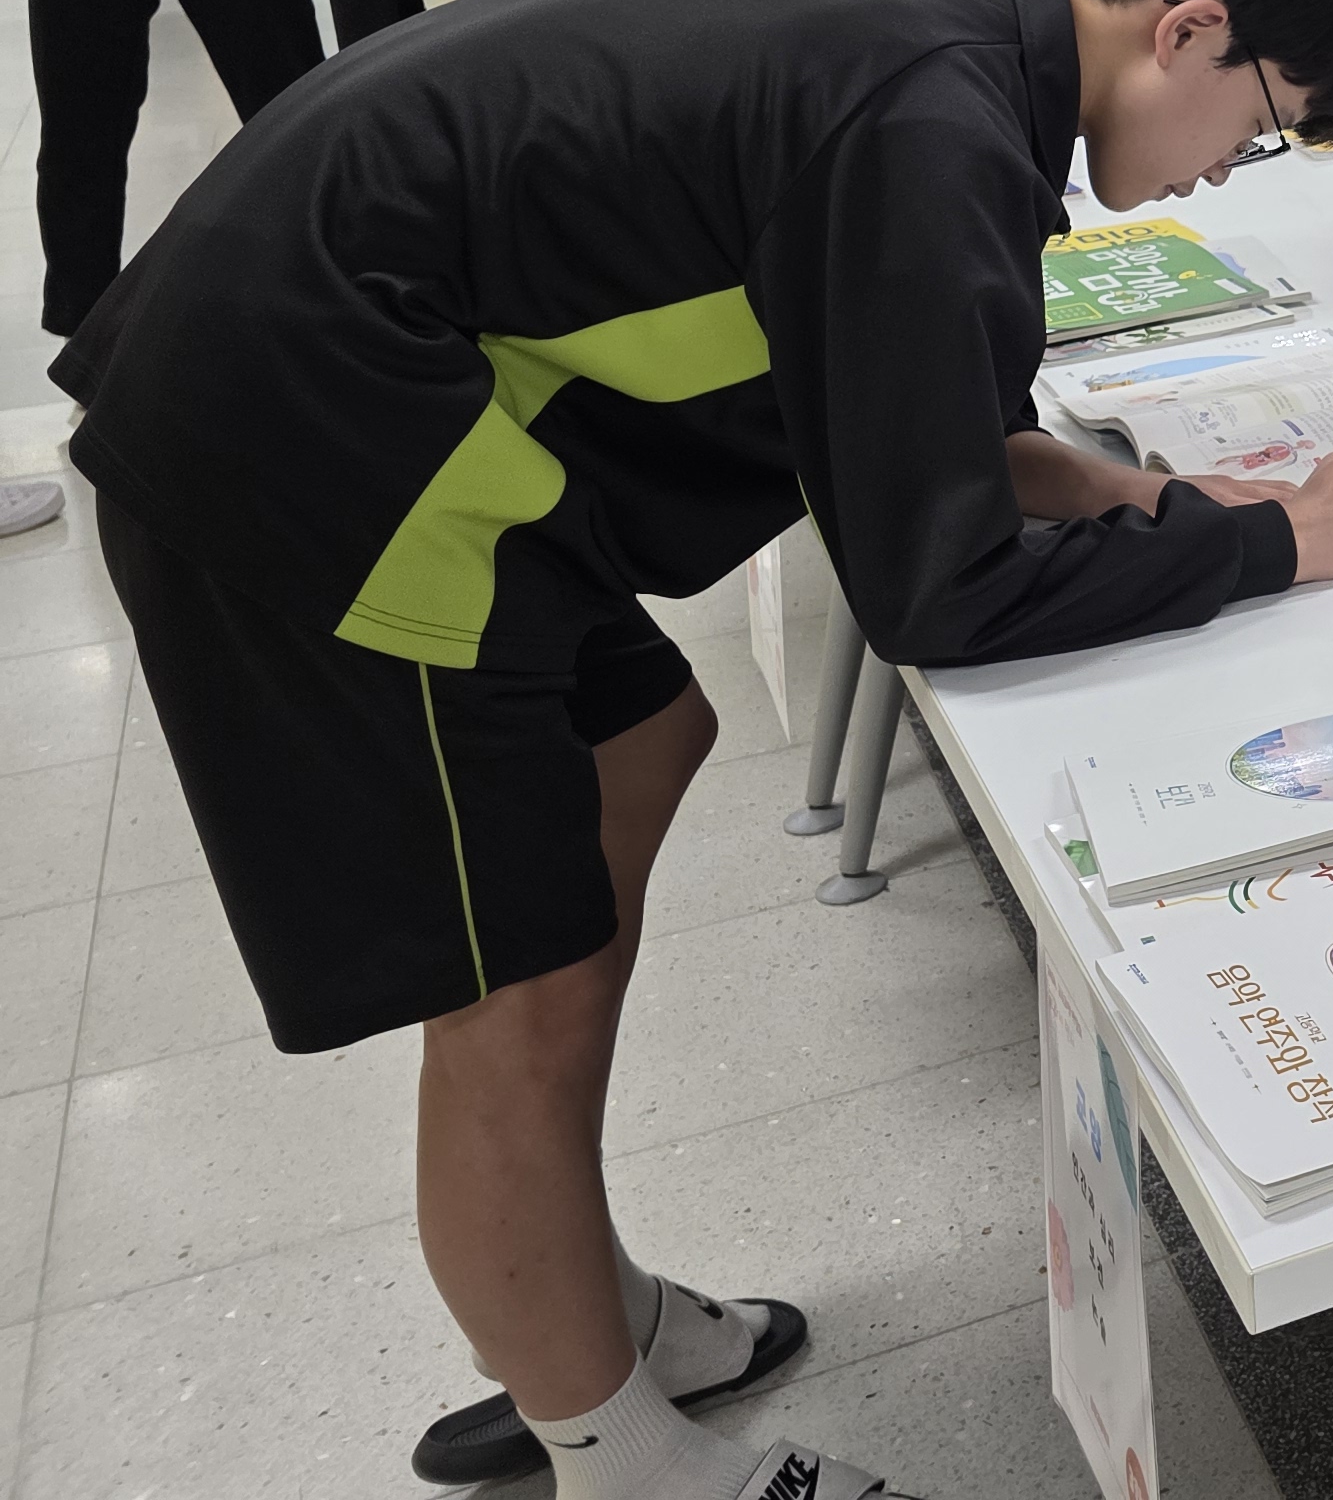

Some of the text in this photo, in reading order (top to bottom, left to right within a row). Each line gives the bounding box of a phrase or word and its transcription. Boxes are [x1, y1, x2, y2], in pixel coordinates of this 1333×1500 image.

[1155, 784, 1196, 810] 보건
[1206, 963, 1267, 1007] 음악
[1239, 1005, 1314, 1075] 연주와
[1293, 1011, 1328, 1045] 고등학교
[1076, 1077, 1101, 1163] 교양
[1072, 1151, 1116, 1266] 인간과 심리
[1089, 1238, 1105, 1288] 보건
